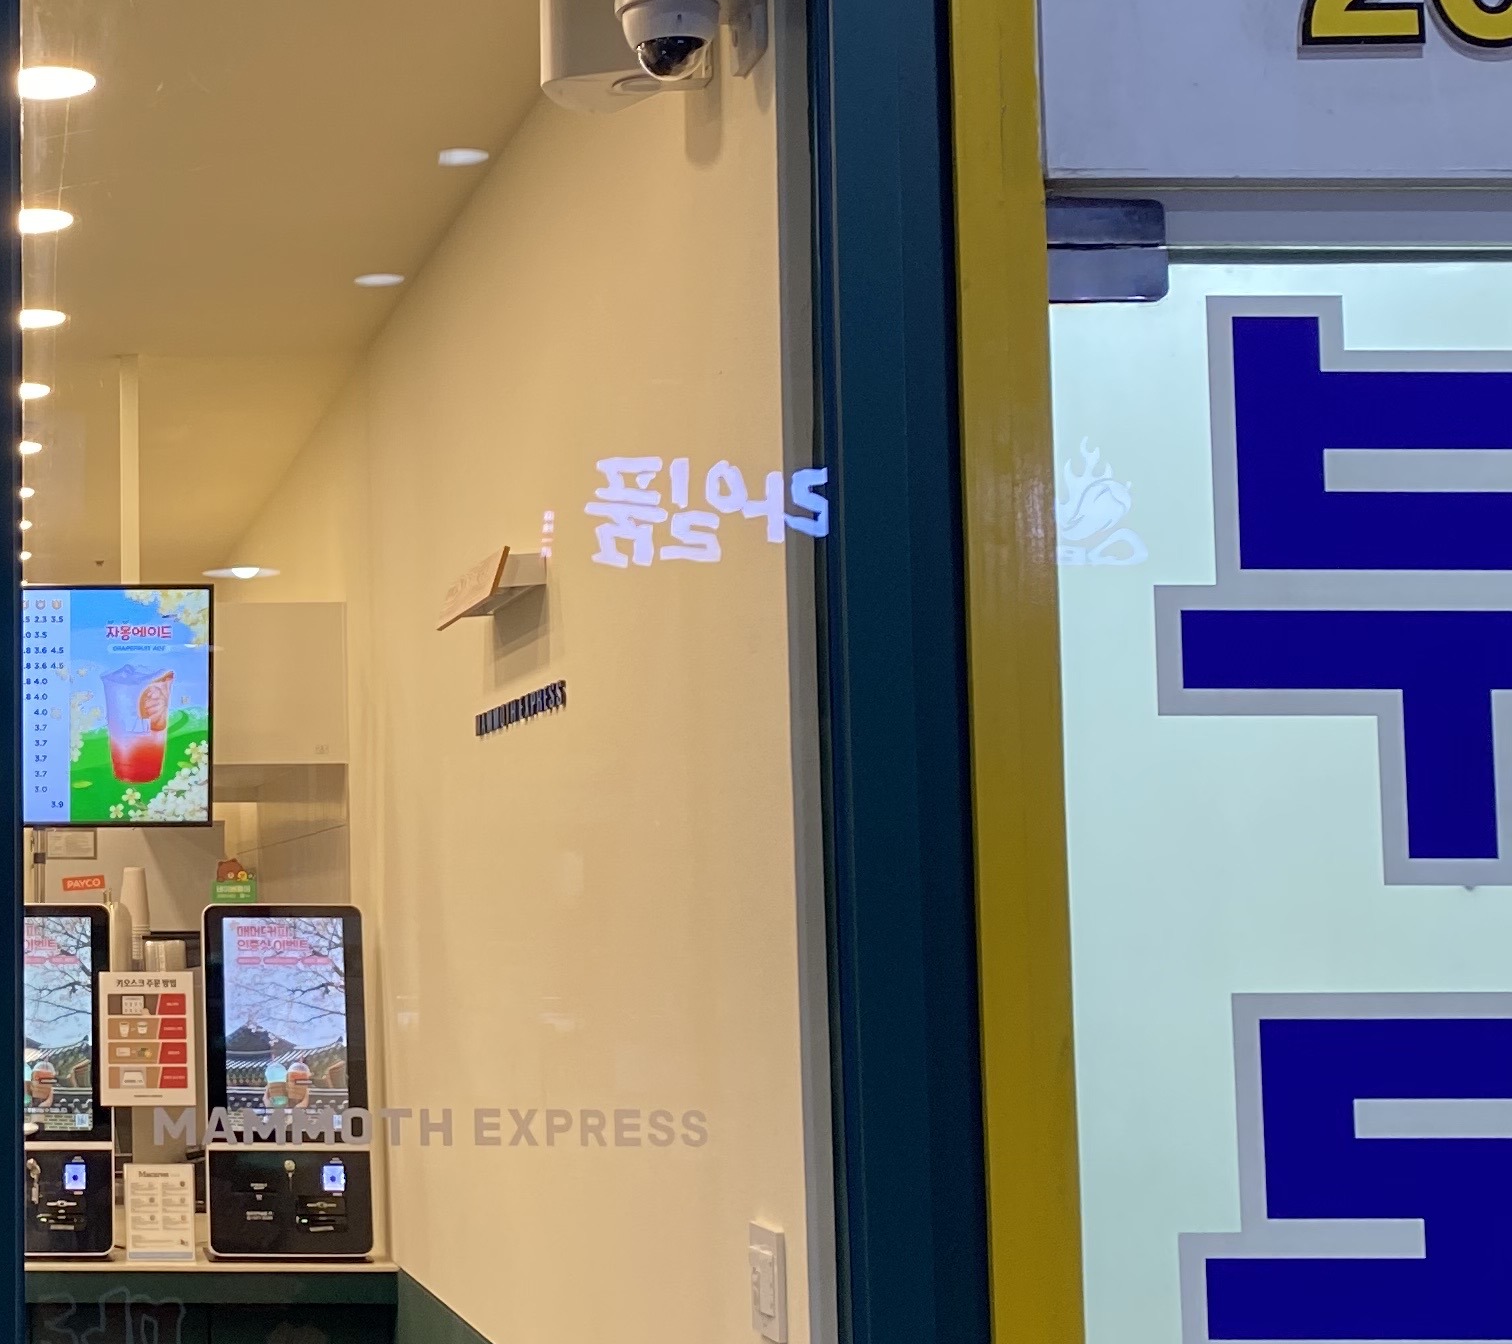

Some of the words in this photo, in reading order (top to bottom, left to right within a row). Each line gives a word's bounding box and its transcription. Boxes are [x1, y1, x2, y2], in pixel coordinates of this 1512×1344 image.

[106, 624, 172, 640] 자몽에이드
[66, 878, 101, 889] PAYCO
[116, 978, 144, 988] 키오스크
[146, 978, 160, 988] 주문
[152, 1107, 453, 1146] MAMMOTH
[474, 1108, 709, 1147] EXPRESS
